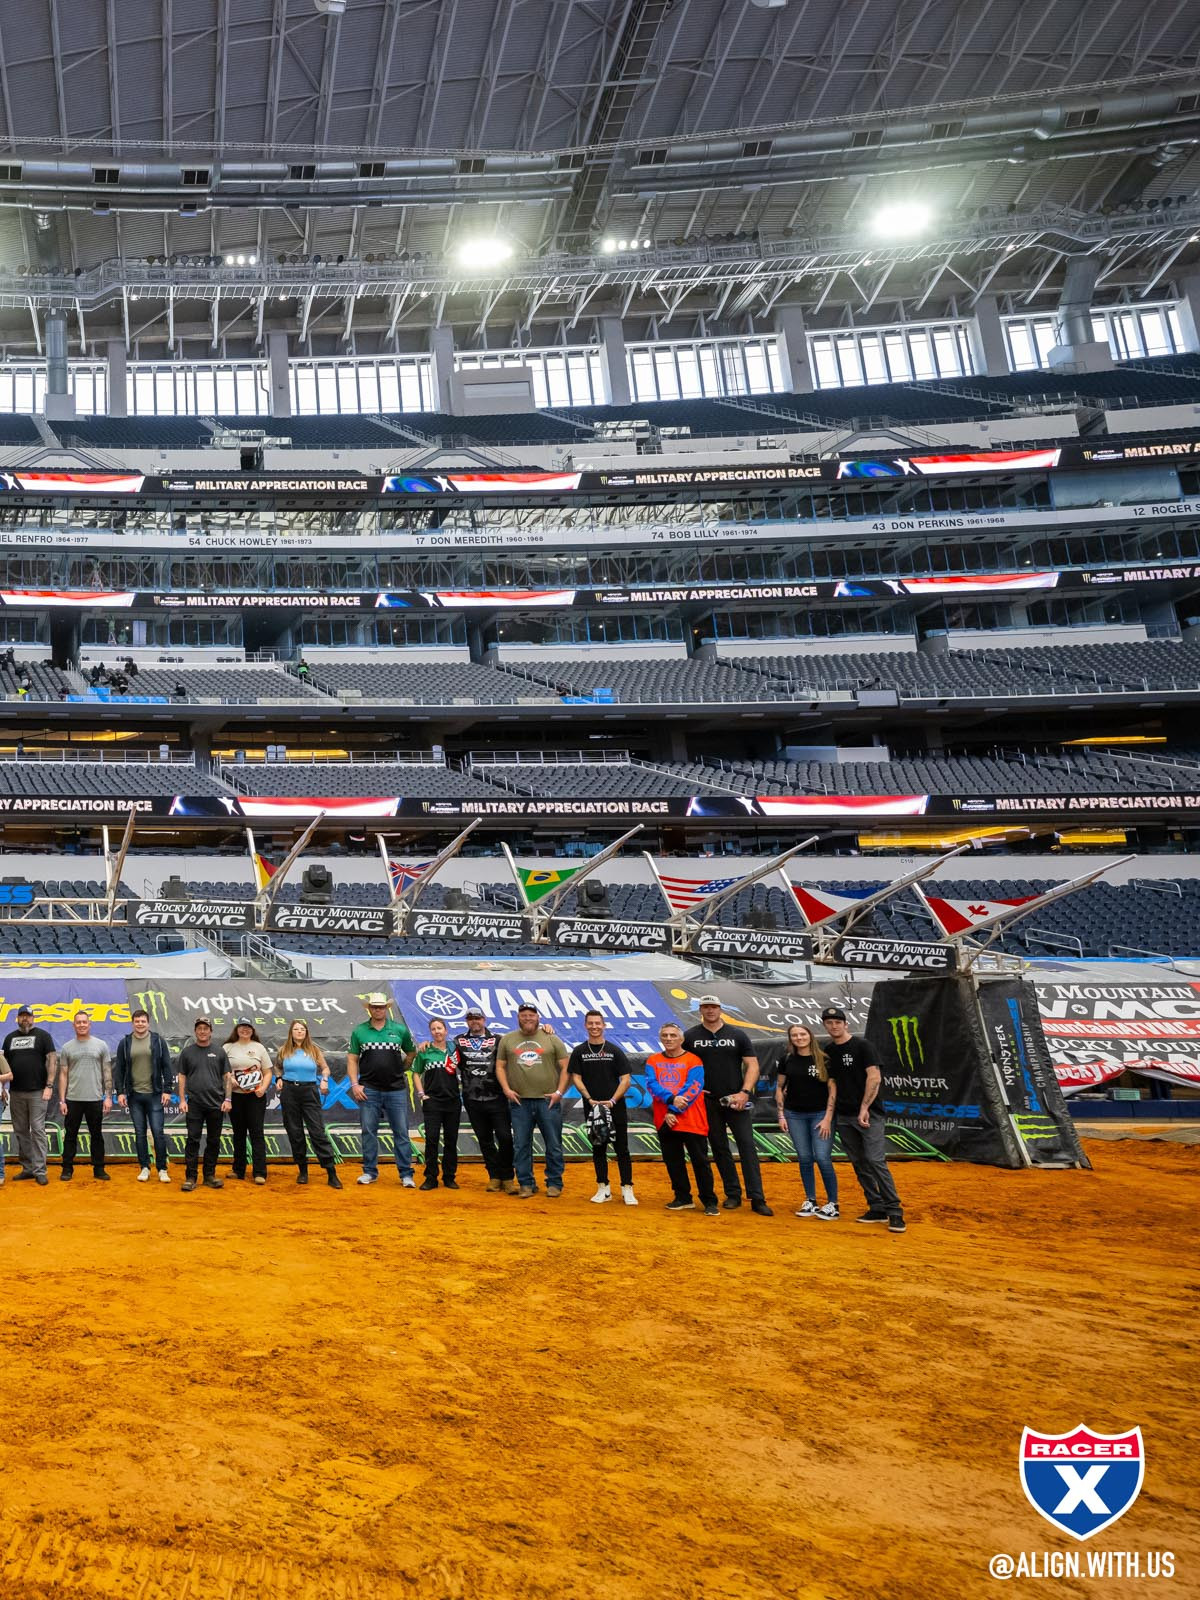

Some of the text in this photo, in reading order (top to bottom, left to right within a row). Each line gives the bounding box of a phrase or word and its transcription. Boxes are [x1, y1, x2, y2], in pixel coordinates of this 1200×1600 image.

[1124, 444, 1191, 457] MILITARY
[636, 472, 692, 484] MILITARY
[694, 468, 784, 481] APPRECIATION
[787, 467, 821, 478] RACE
[195, 480, 249, 491] MILITARY
[251, 480, 335, 490] APPRECIATION
[338, 480, 368, 490] RACE
[1133, 505, 1191, 516] 12 ROGER
[872, 522, 886, 531] 43
[892, 520, 914, 530] DON
[918, 518, 964, 529] PERKINS
[15, 535, 53, 544] RENFRO
[416, 537, 425, 545] 17
[430, 536, 451, 545] DON
[454, 536, 503, 545] MEREDITH
[652, 530, 664, 540] 74
[669, 529, 691, 540] BOB
[693, 529, 719, 539] LILLY
[189, 538, 200, 546] 54
[205, 538, 236, 546] CHUCK
[239, 537, 278, 546] HOWLEY
[1124, 568, 1191, 581] MILITARY
[631, 589, 689, 600] MILITARY
[690, 587, 780, 599] APPRECIATION
[783, 586, 817, 596] RACE
[186, 596, 241, 606] MILITARY
[241, 596, 330, 606] APPRECIATION
[332, 596, 360, 606] RACE
[14, 798, 114, 810] APPRECIATION
[462, 802, 524, 813] MILITARY
[525, 802, 628, 813] APPRECIATION
[631, 802, 668, 813] RACE
[996, 798, 1066, 810] MILITARY
[1069, 797, 1183, 808] APPRECIATION
[153, 902, 246, 914] ROCKY MOUNTAIN
[292, 906, 384, 919] ROCKY MOUNTAIN
[431, 914, 522, 926] ROCKY MOUNTAIN
[573, 922, 606, 932] ROCKY
[714, 931, 802, 946] ROCKY MOUNTAIN
[858, 941, 947, 956] ROCKY MOUNTAIN
[1053, 985, 1195, 999] MOUNTAIN
[181, 993, 347, 1015] MONSTER
[462, 988, 656, 1018] YAMAHA
[751, 997, 821, 1010] UTAH
[995, 1024, 1015, 1086] MONSTER
[1022, 1021, 1046, 1089] CHAMPIONSHIP
[237, 1072, 262, 1087] 222
[884, 1076, 949, 1090] MONSTER
